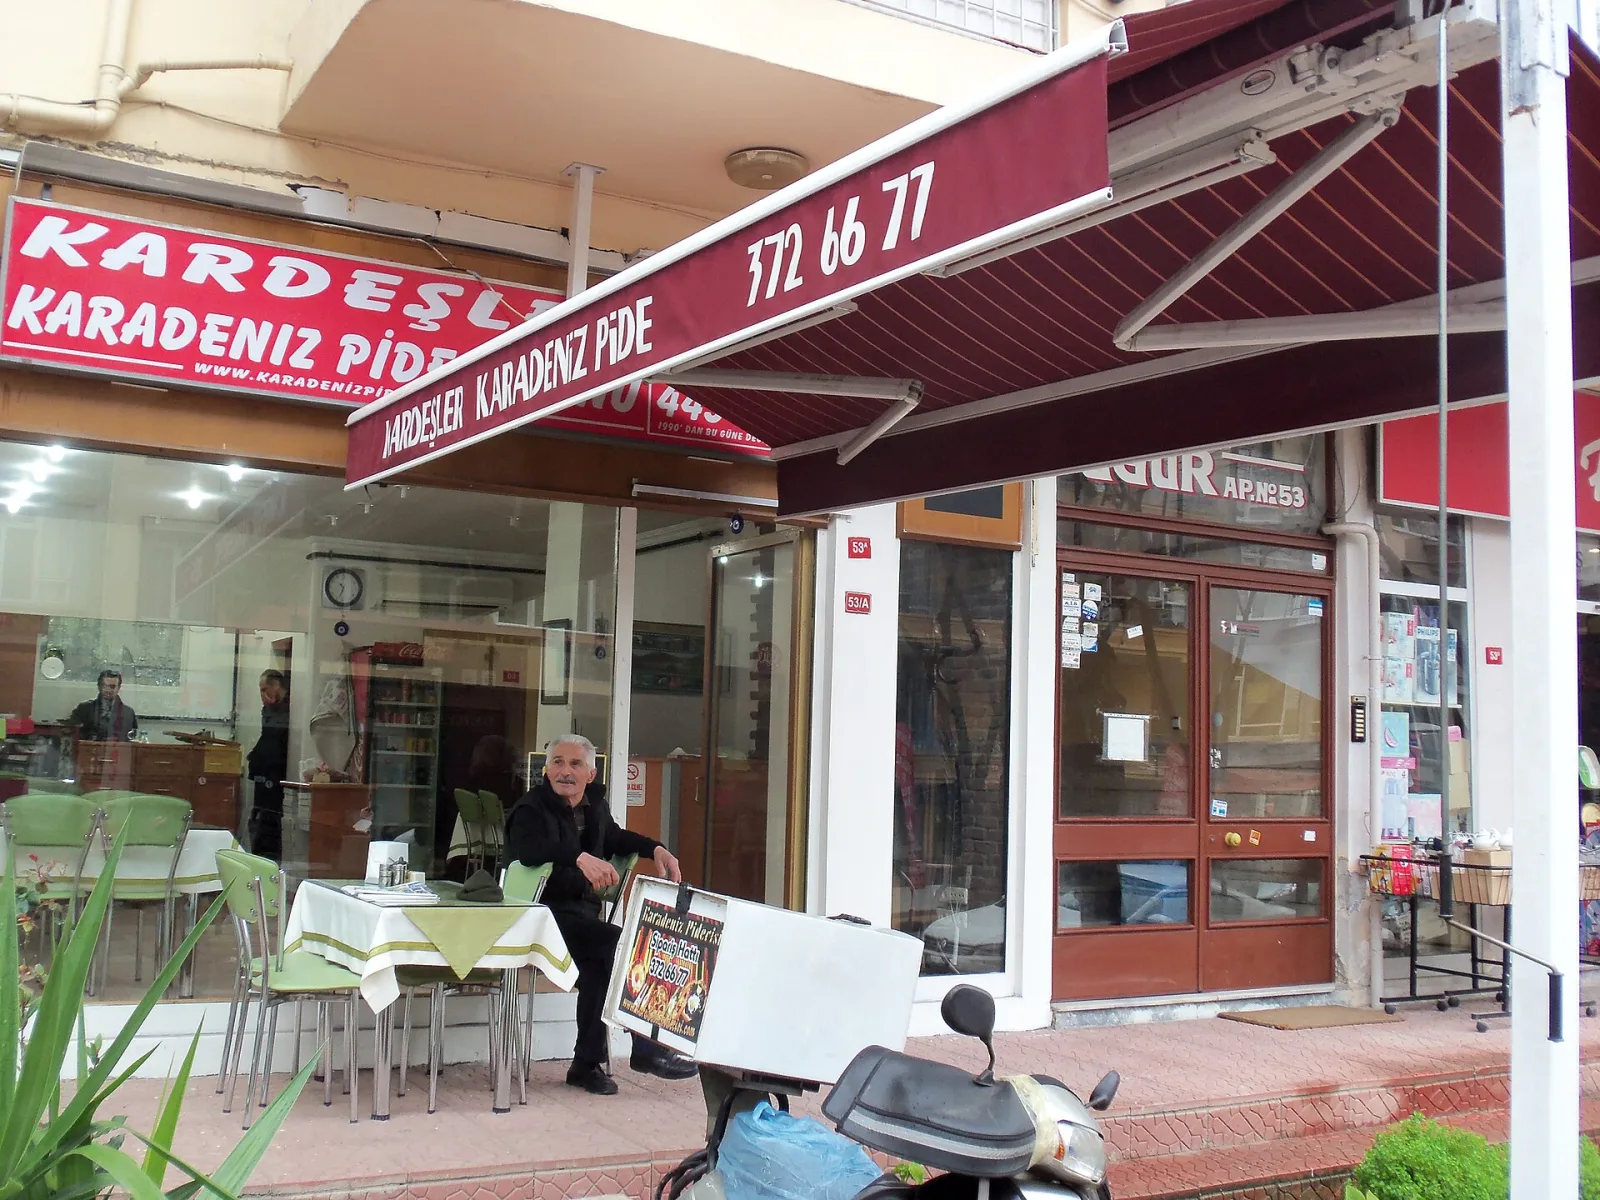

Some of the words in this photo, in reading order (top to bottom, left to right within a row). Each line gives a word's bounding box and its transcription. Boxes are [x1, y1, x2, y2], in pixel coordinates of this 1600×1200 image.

[746, 222, 803, 307] 372
[820, 195, 866, 275] 66
[881, 160, 935, 251] 77
[475, 323, 589, 421] KARADENİZ
[594, 295, 653, 372] PİDE
[685, 423, 703, 435] DAN
[706, 427, 718, 437] BU
[720, 429, 743, 441] GÜNE
[847, 596, 869, 609] 53/A
[642, 905, 684, 934] Karadeniz
[650, 957, 665, 979] 372
[665, 963, 677, 982] 66
[677, 967, 690, 986] 77
